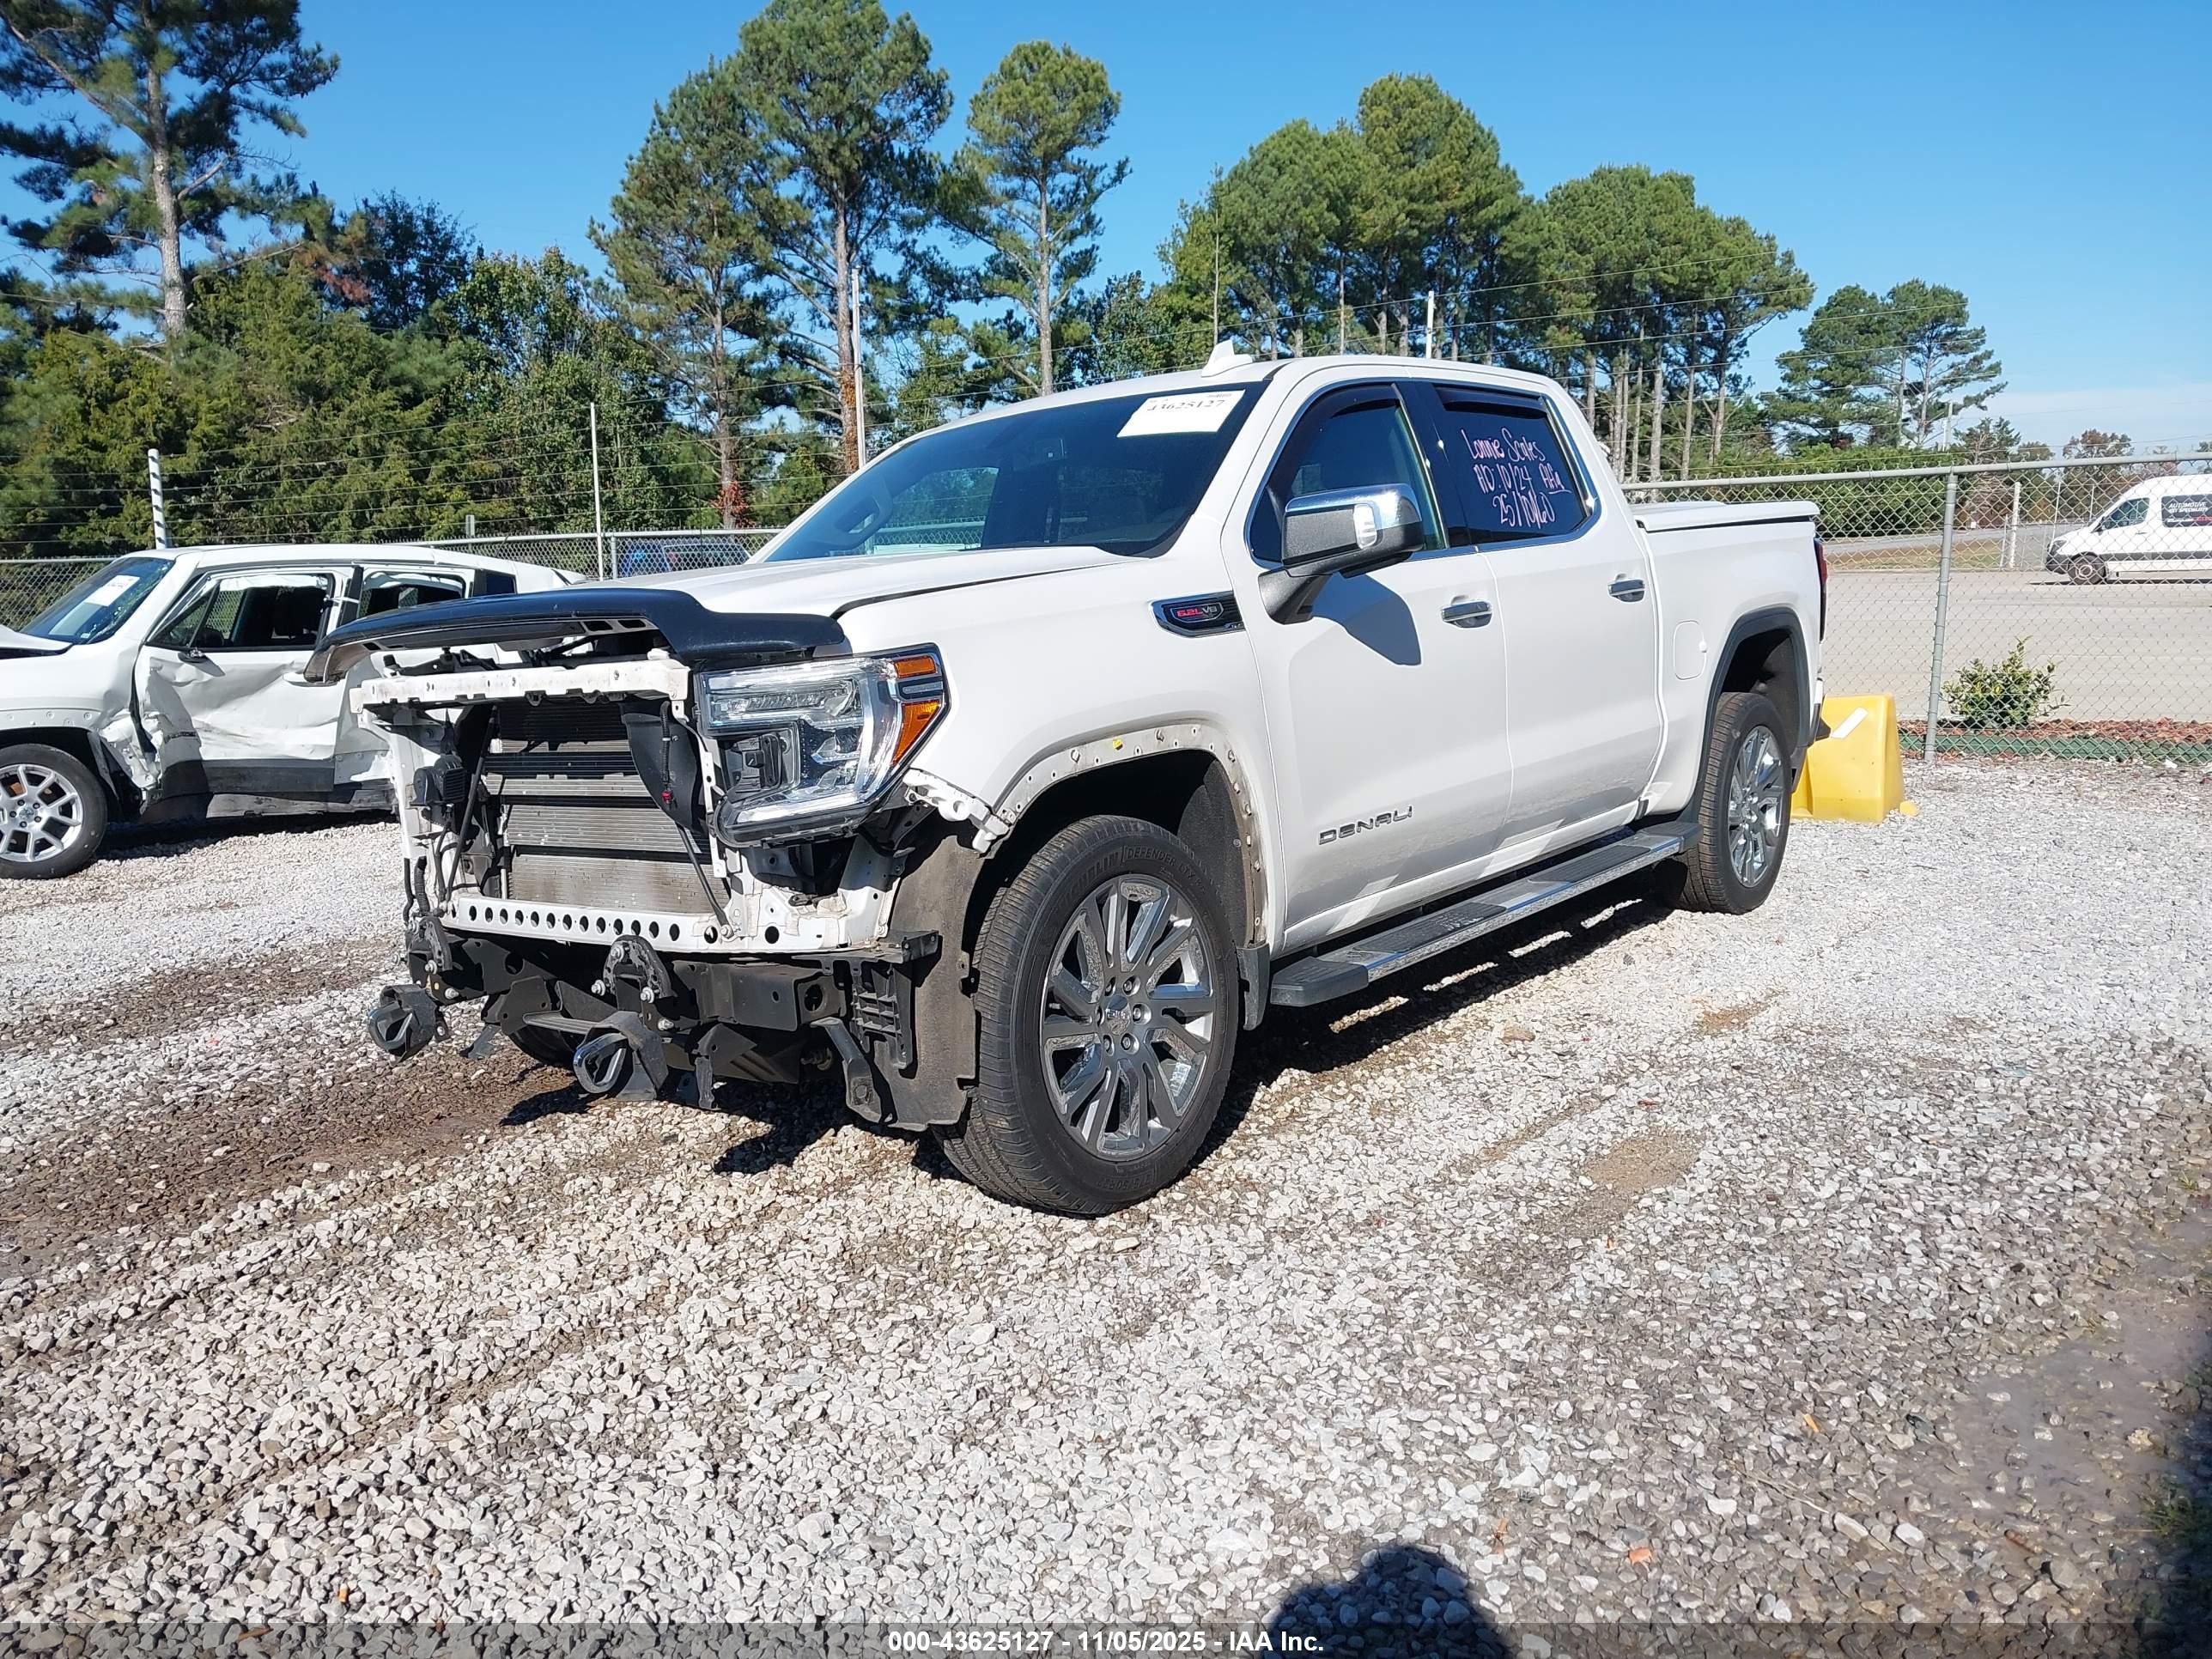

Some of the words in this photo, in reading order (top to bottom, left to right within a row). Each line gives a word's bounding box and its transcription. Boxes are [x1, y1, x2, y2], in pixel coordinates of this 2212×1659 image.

[1501, 428, 1546, 462] Scales
[1319, 805, 1413, 845] DENALI
[1127, 846, 1176, 866] DEFENDER
